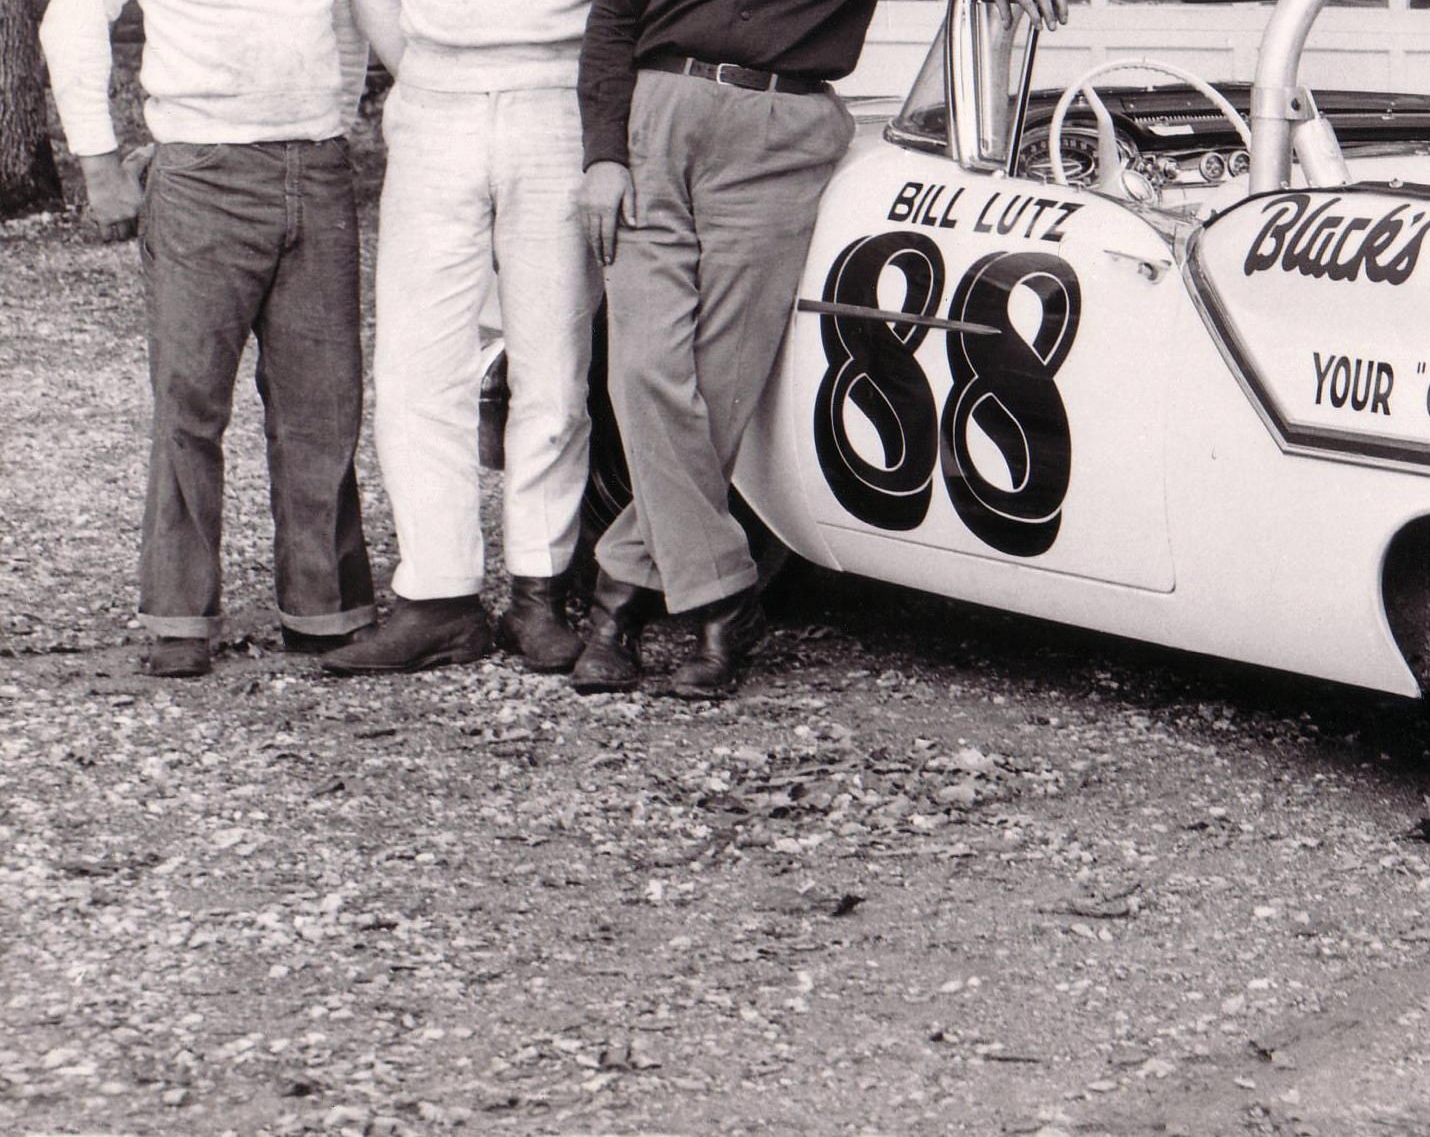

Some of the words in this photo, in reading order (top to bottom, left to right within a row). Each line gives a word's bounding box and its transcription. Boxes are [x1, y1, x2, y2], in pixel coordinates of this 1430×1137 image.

[886, 181, 959, 229] BILL
[973, 191, 1084, 243] LUTZ
[813, 230, 1082, 558] 88
[1313, 352, 1394, 416] YOUR
